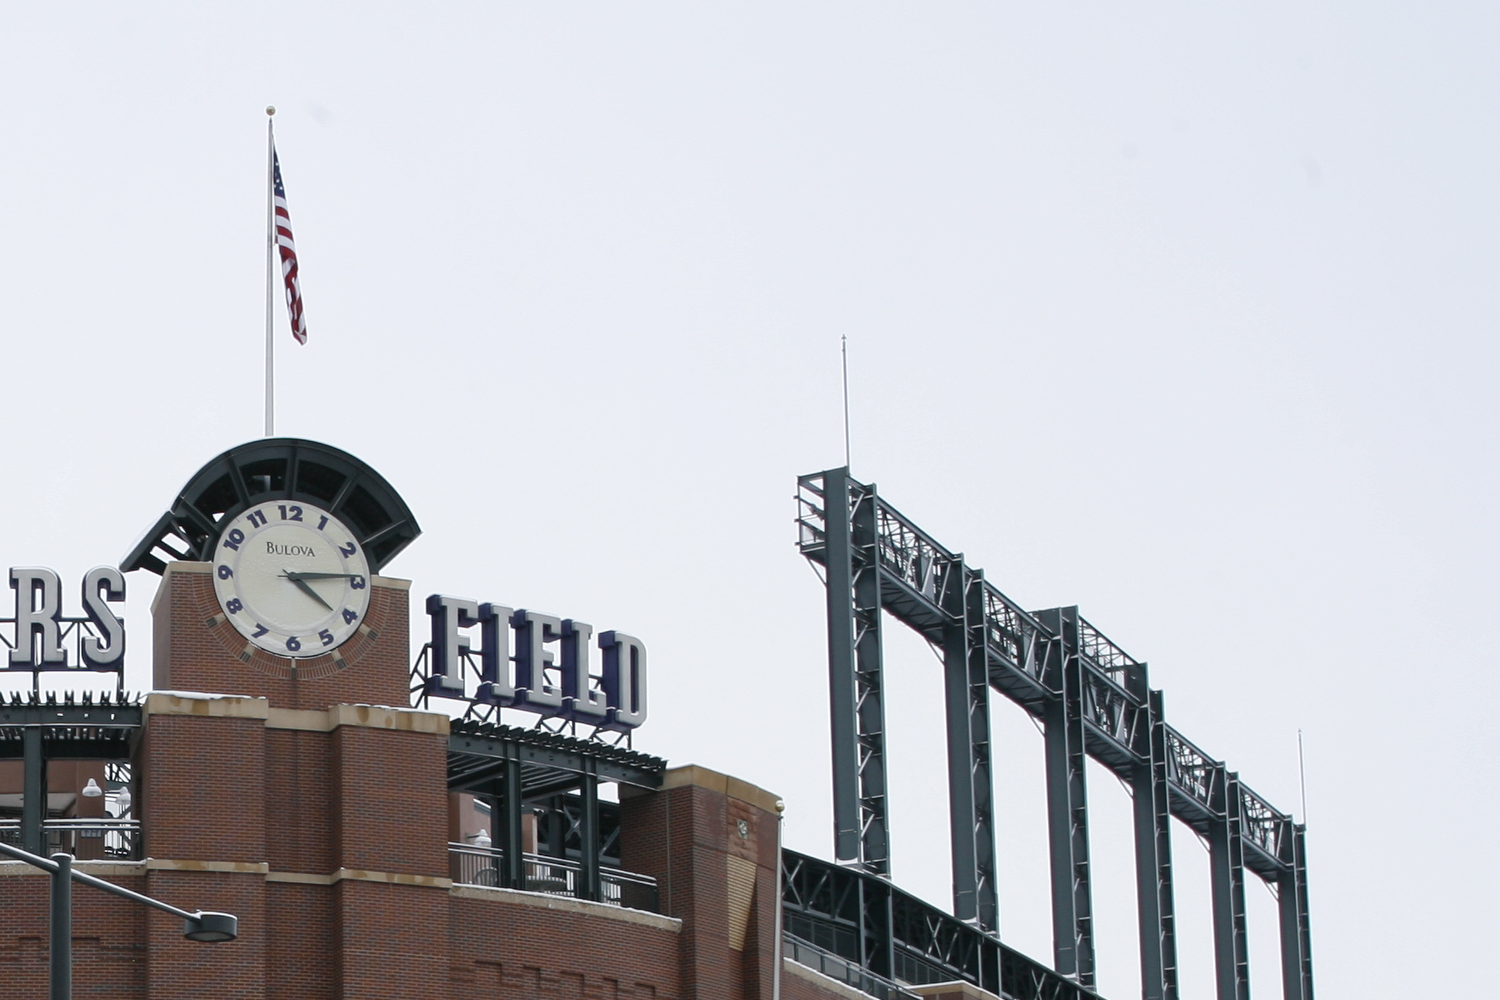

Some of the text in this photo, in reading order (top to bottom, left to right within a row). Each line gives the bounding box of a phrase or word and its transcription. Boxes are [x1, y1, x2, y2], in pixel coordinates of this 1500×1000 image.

[246, 509, 268, 529] 11
[278, 505, 303, 522] 12
[317, 515, 329, 531] 1
[223, 528, 245, 551] 10
[266, 541, 316, 557] BULOVA
[338, 541, 357, 559] 2
[218, 564, 234, 580] 9
[350, 575, 366, 590] 3
[226, 598, 243, 614] 8
[342, 608, 358, 625] 4
[251, 623, 270, 639] 7
[318, 629, 334, 646] 5
[286, 636, 301, 651] 6
[426, 593, 650, 732] FIELD
